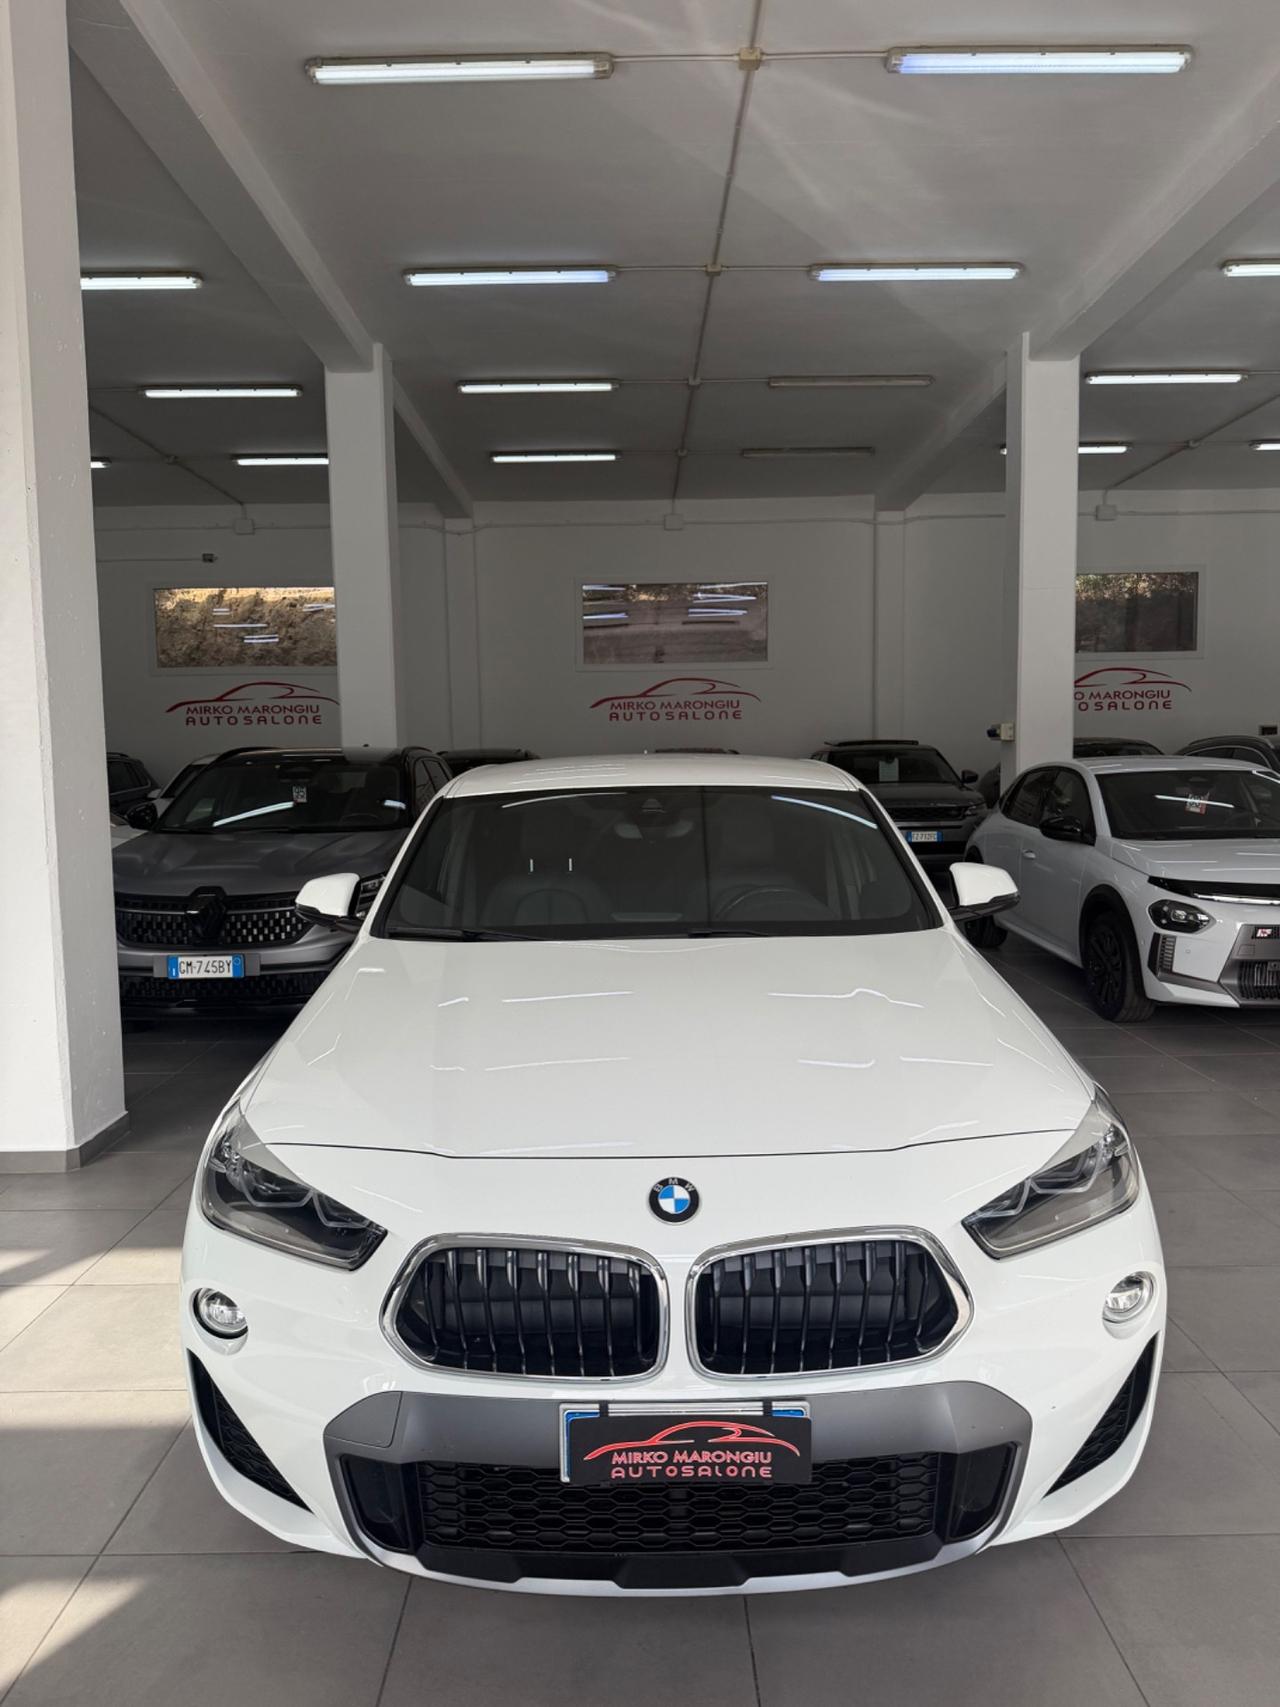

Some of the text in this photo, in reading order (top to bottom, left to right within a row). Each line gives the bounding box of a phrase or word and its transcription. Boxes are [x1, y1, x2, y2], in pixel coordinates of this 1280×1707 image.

[1089, 689, 1170, 700] MARONGIU
[186, 704, 320, 715] MIRKO MARONGIU
[610, 699, 740, 711] MIRKO MARONGIU
[1077, 700, 1172, 711] OSALONE
[185, 715, 322, 726] AUTOSALONE
[609, 710, 742, 721] AUTOSALONE
[611, 1449, 772, 1464] MIRKO MARONGIU
[611, 1465, 772, 1478] AUTOSALONE
